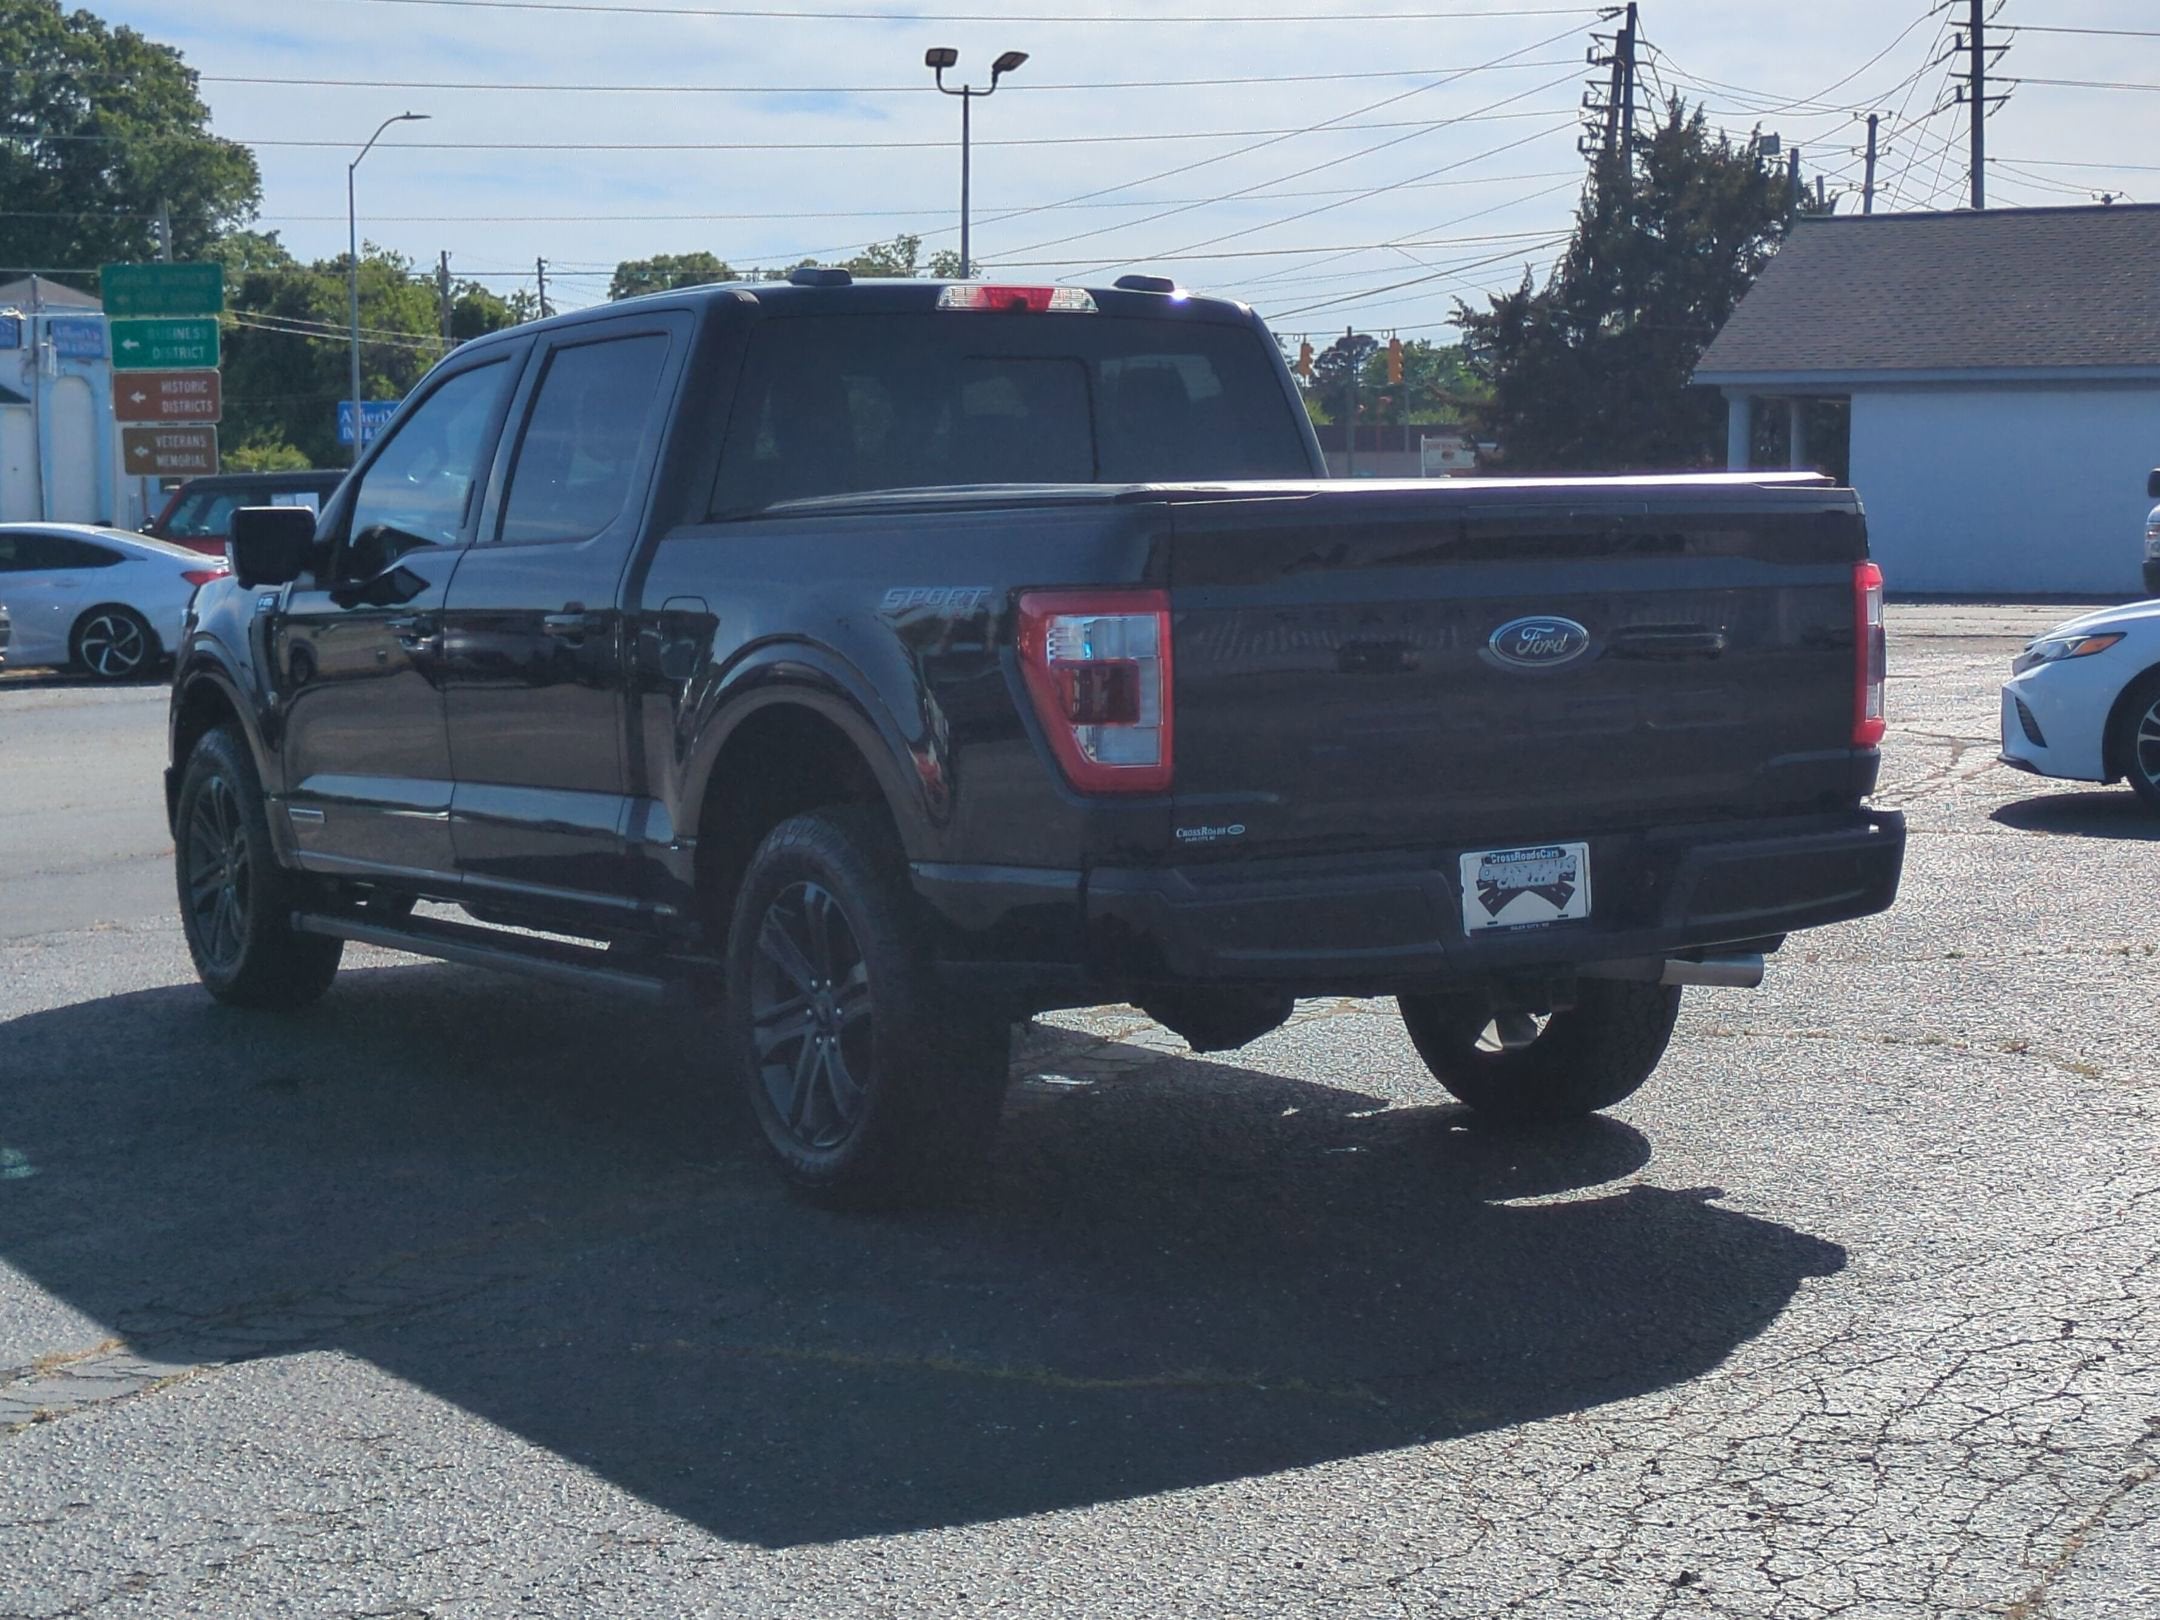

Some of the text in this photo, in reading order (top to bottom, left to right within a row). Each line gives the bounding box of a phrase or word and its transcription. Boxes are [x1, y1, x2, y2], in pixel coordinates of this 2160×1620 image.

[152, 346, 205, 360] DISTRICT
[161, 380, 208, 393] HISTORIC
[162, 400, 213, 413] DISTRICTS
[156, 435, 207, 448] VETERANS
[157, 454, 208, 467] MEMORIAL
[881, 586, 992, 609] SPORT
[1516, 627, 1568, 656] Ford
